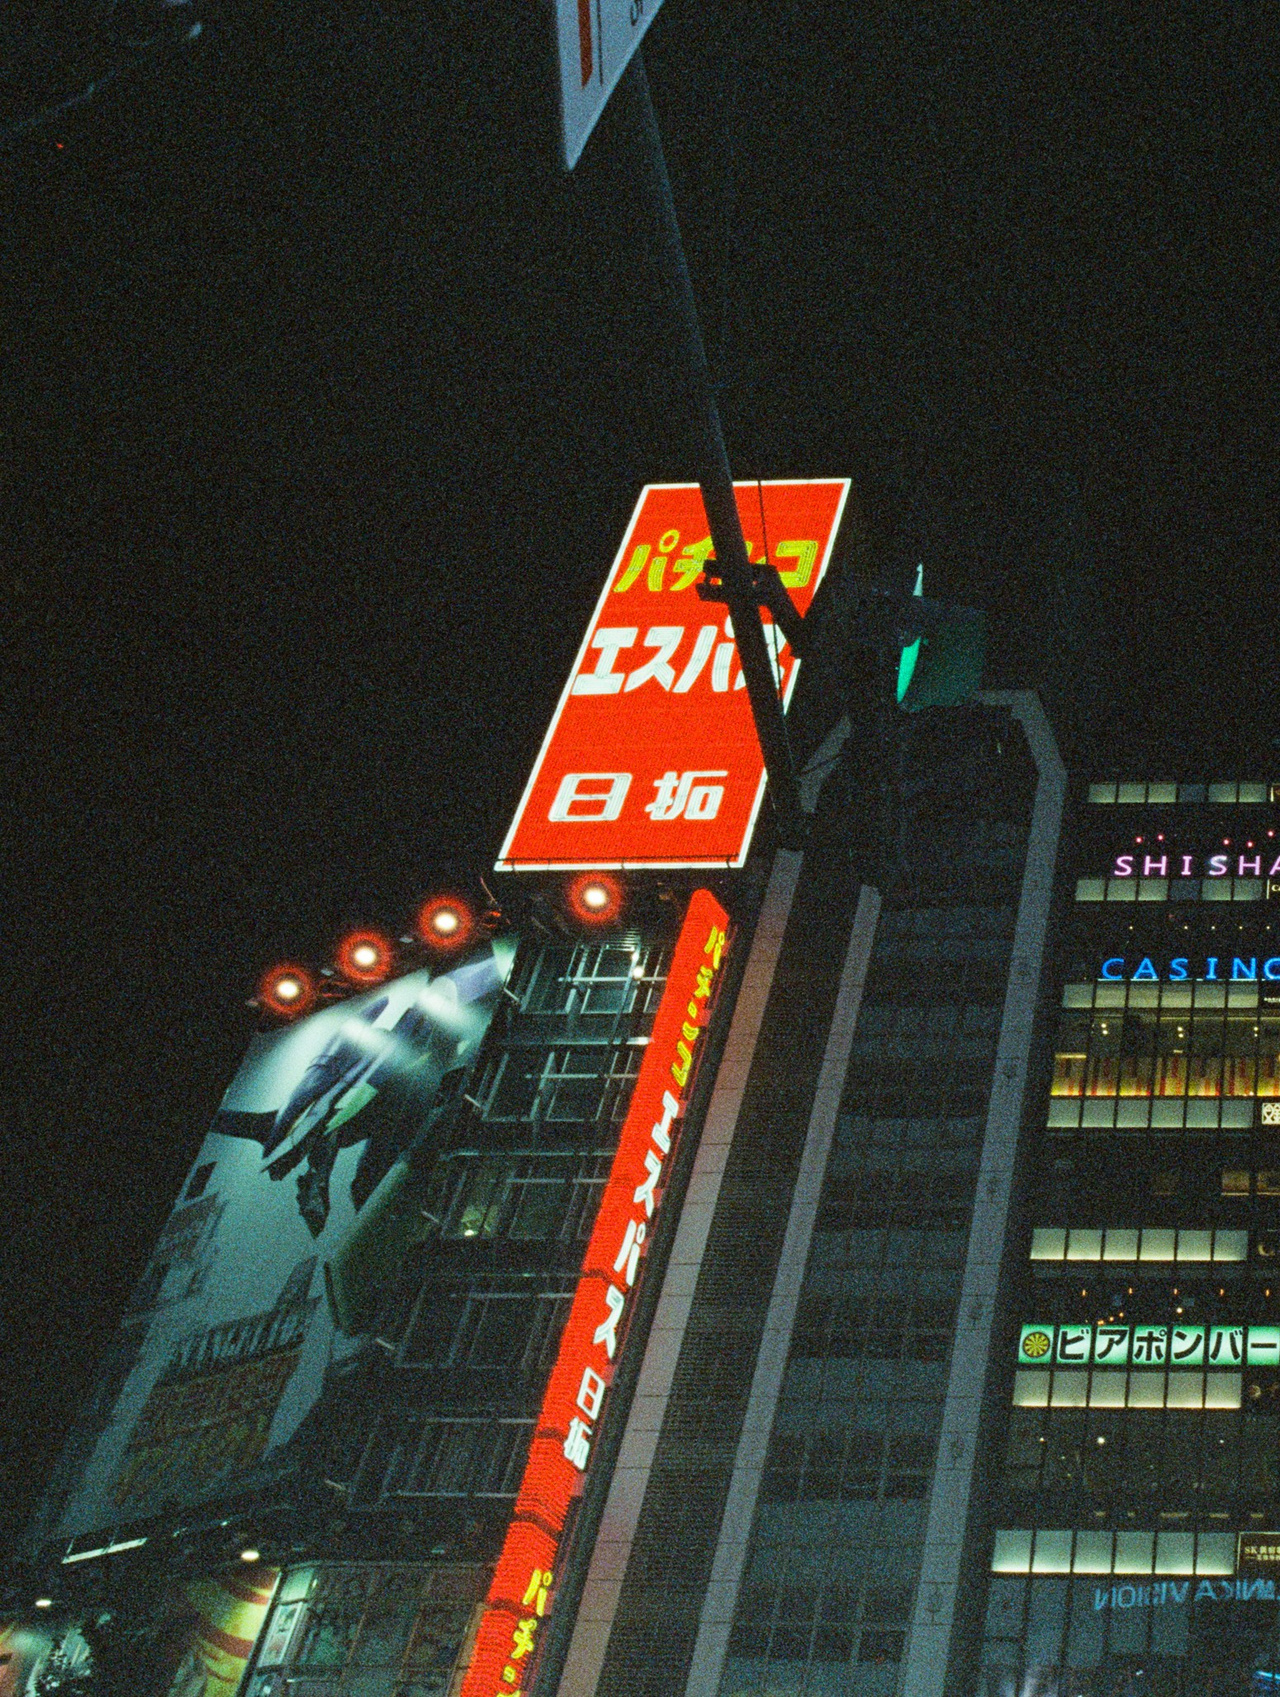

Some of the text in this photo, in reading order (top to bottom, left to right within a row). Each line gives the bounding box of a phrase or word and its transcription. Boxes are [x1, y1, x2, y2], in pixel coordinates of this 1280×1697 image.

[613, 529, 819, 592] パチコ
[549, 770, 729, 823] 日拓
[671, 925, 726, 1087] パチンコ
[593, 1089, 679, 1358] エスパス
[1058, 1328, 1278, 1361] ビアポンバー
